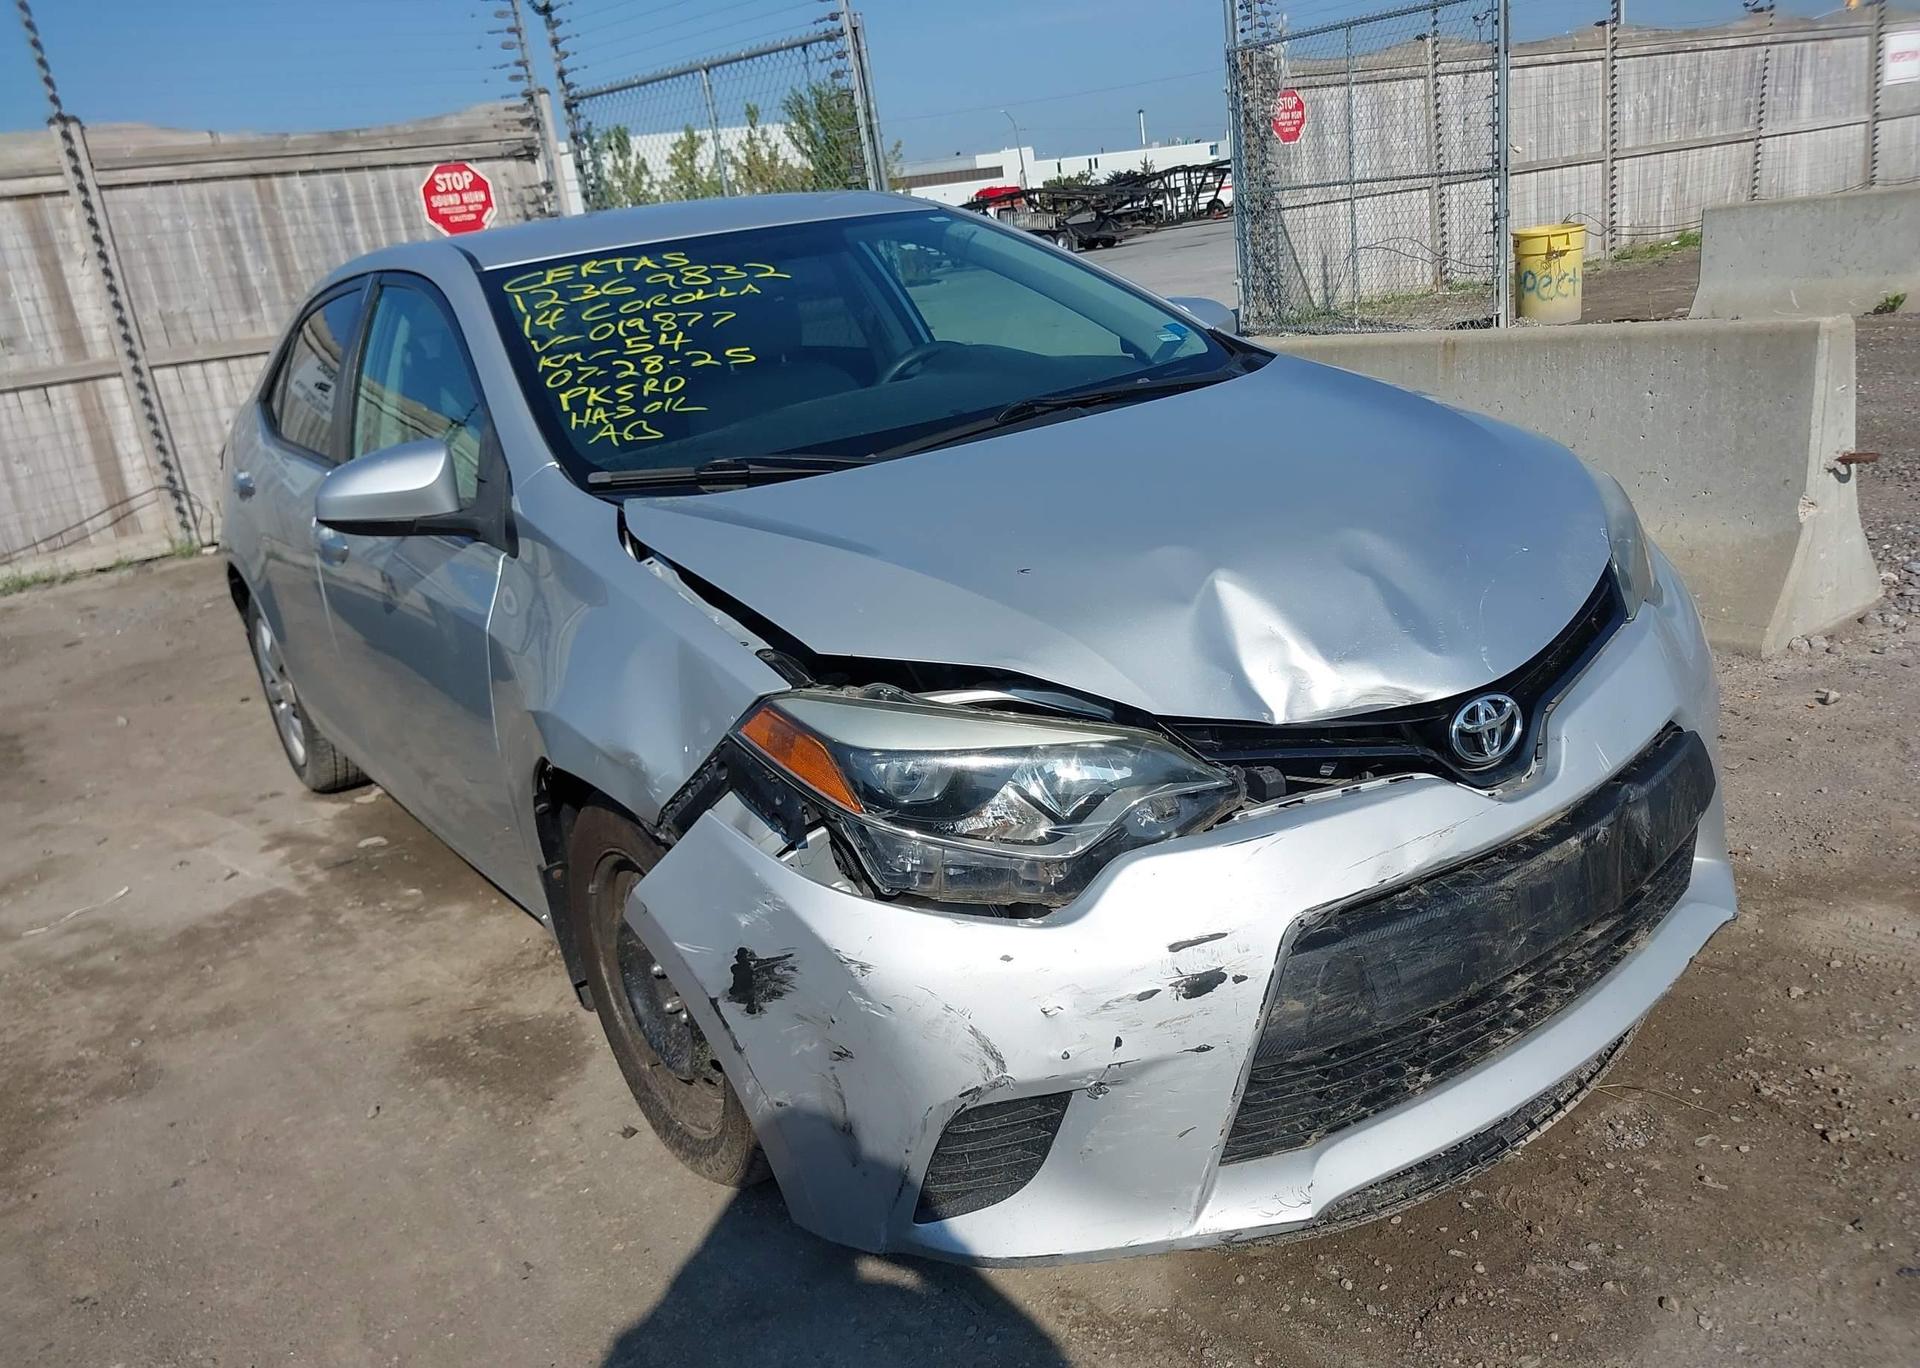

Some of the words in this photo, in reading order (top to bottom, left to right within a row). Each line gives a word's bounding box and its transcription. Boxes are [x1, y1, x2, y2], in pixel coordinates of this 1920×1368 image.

[1279, 97, 1297, 110] STOP
[434, 171, 474, 192] STOP
[503, 252, 690, 292] CERTAS
[523, 307, 566, 339] 14
[581, 283, 761, 321] COROLLA
